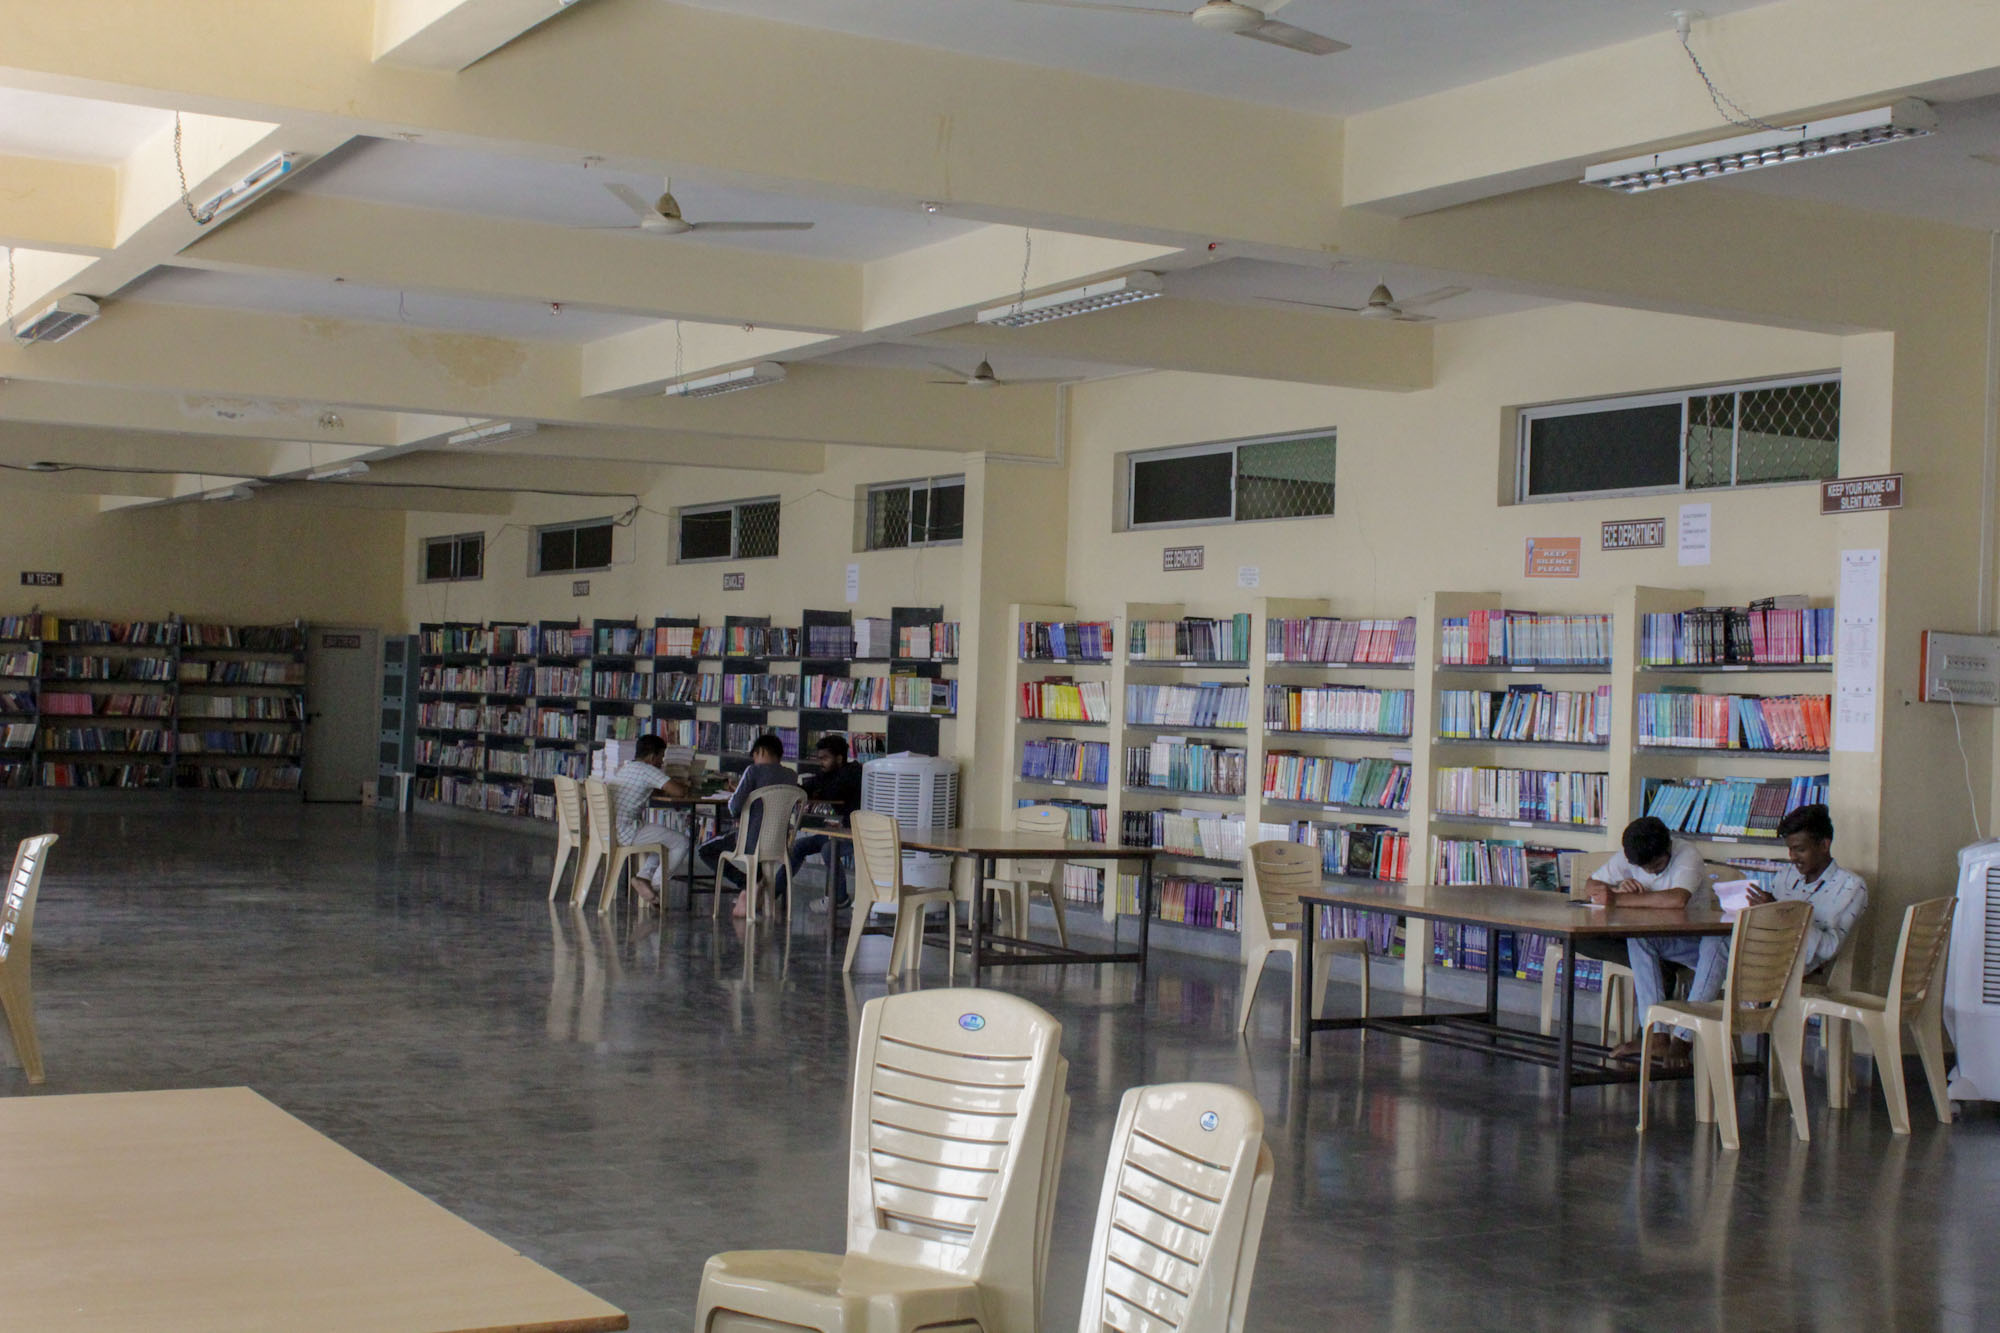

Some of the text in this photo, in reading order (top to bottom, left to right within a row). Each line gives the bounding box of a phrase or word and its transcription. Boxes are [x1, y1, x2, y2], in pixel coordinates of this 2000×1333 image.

[1828, 479, 1896, 497] KEEP YOUR PHONE ON
[1841, 494, 1882, 509] SILENT MODE
[1603, 524, 1618, 547] ECE
[1618, 521, 1664, 546] DEPARTMENT
[1174, 549, 1203, 567] DEPARTMENT
[36, 573, 57, 584] TECH
